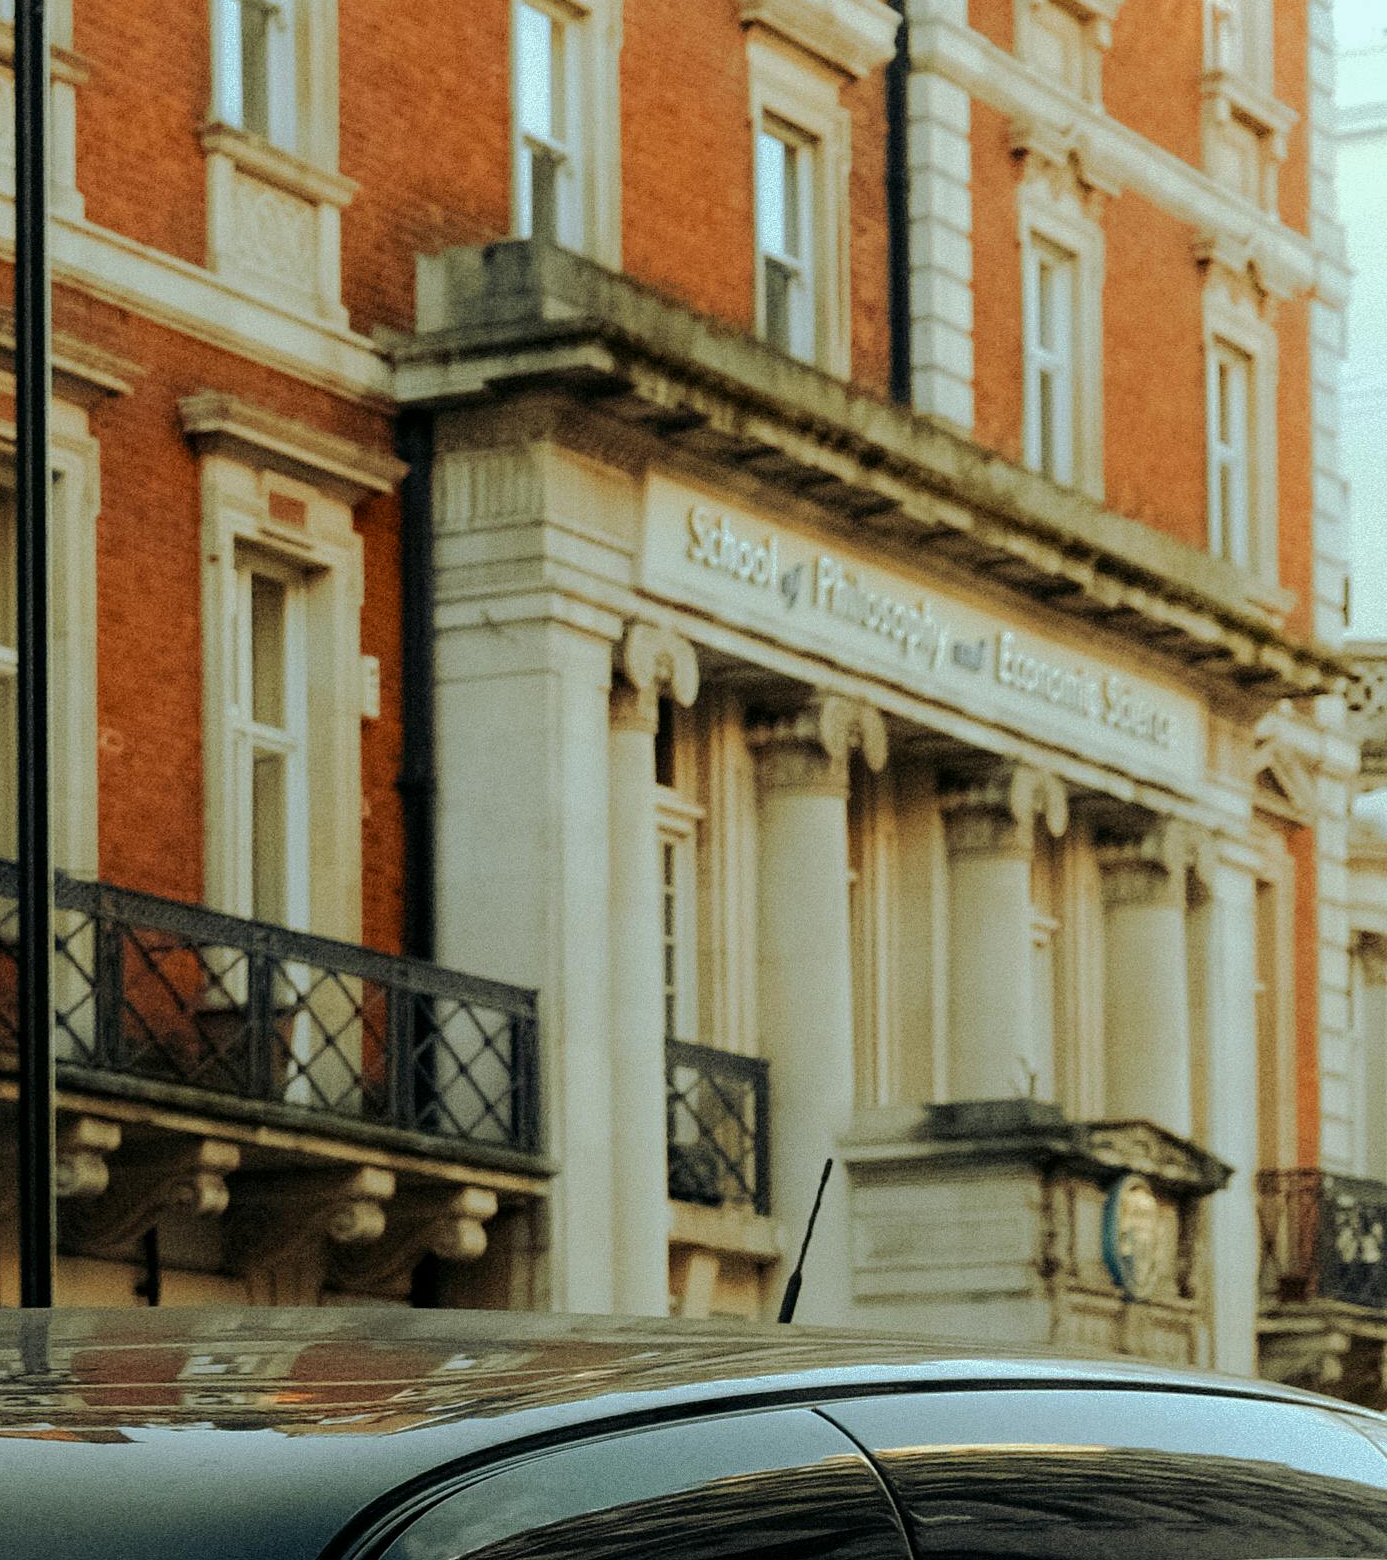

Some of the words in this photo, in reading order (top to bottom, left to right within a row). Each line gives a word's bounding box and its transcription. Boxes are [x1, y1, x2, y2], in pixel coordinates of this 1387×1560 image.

[686, 502, 779, 586] School
[779, 562, 804, 610] of
[809, 551, 949, 673] Philosophy
[951, 638, 987, 673] and
[993, 629, 1103, 718] Economic
[1098, 674, 1176, 752] Science
